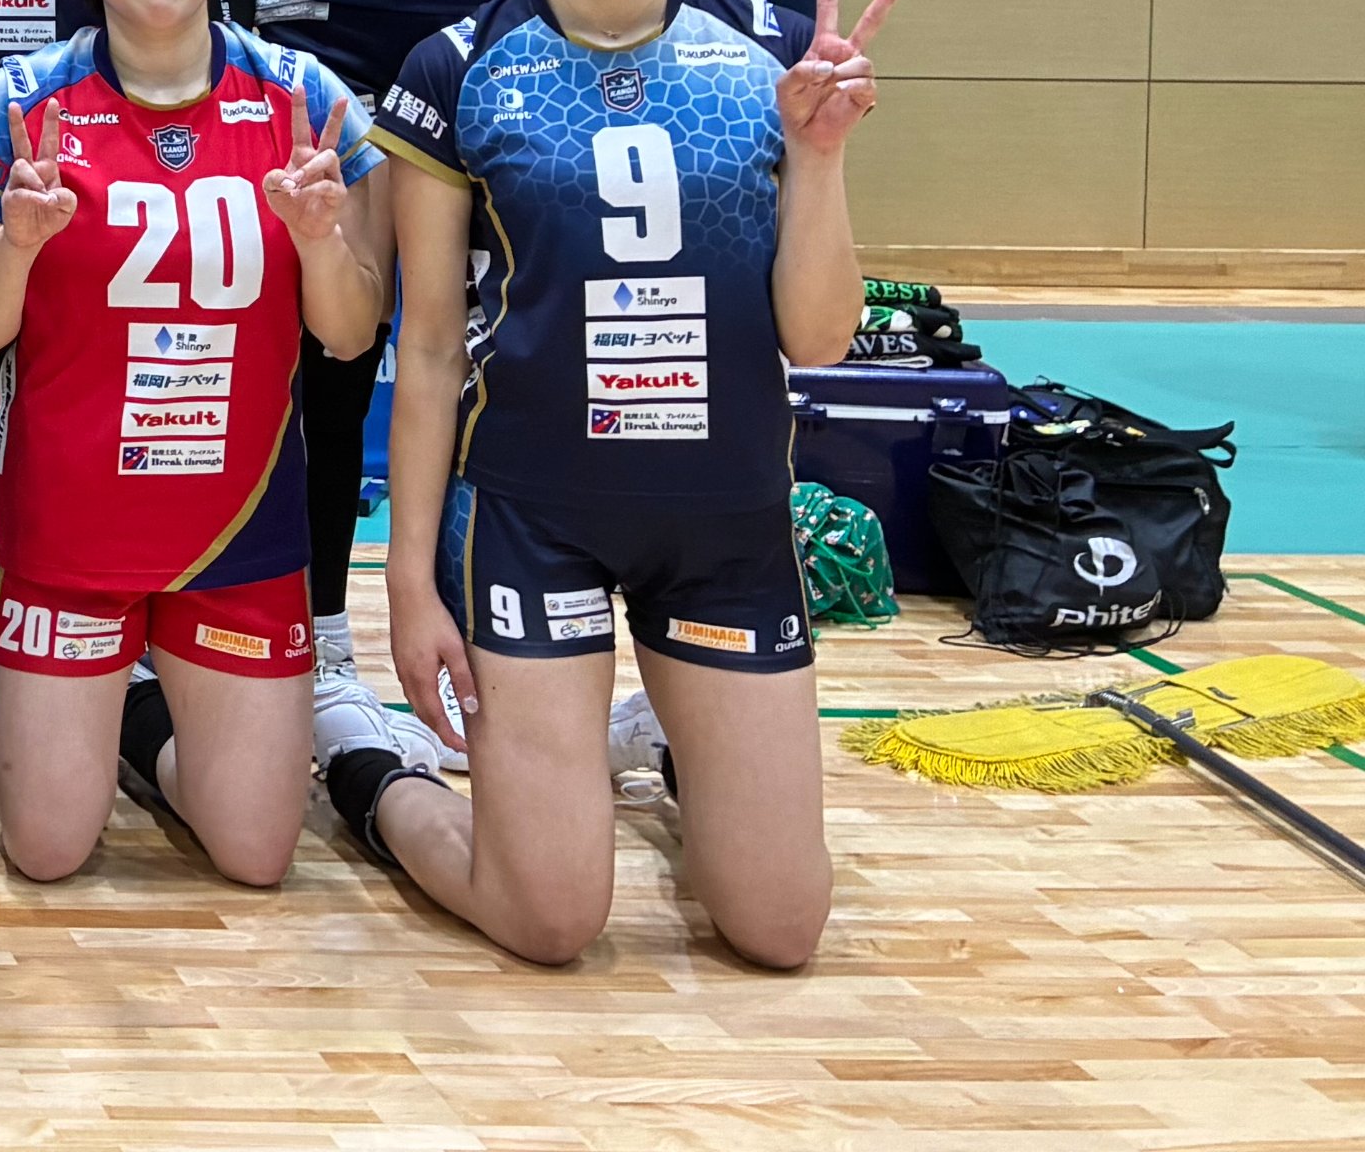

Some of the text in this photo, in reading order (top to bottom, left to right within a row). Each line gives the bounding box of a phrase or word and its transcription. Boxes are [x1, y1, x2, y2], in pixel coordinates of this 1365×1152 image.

[21, 34, 54, 45] through
[532, 59, 561, 71] JACK
[90, 113, 119, 124] JACK
[591, 123, 683, 263] 9
[107, 175, 265, 309] 20
[637, 295, 677, 306] Shinryo
[176, 340, 211, 353] Shinryo
[593, 331, 700, 347] 福岡トヨペット
[133, 373, 226, 388] 福岡トヨペット
[597, 372, 699, 390] Yakult
[130, 410, 221, 427] Yakult
[625, 421, 706, 433] Break through
[151, 456, 222, 469] Break through
[489, 584, 525, 639] 9
[204, 628, 265, 649] TOMINAGA
[676, 620, 747, 643] TOMINAGA
